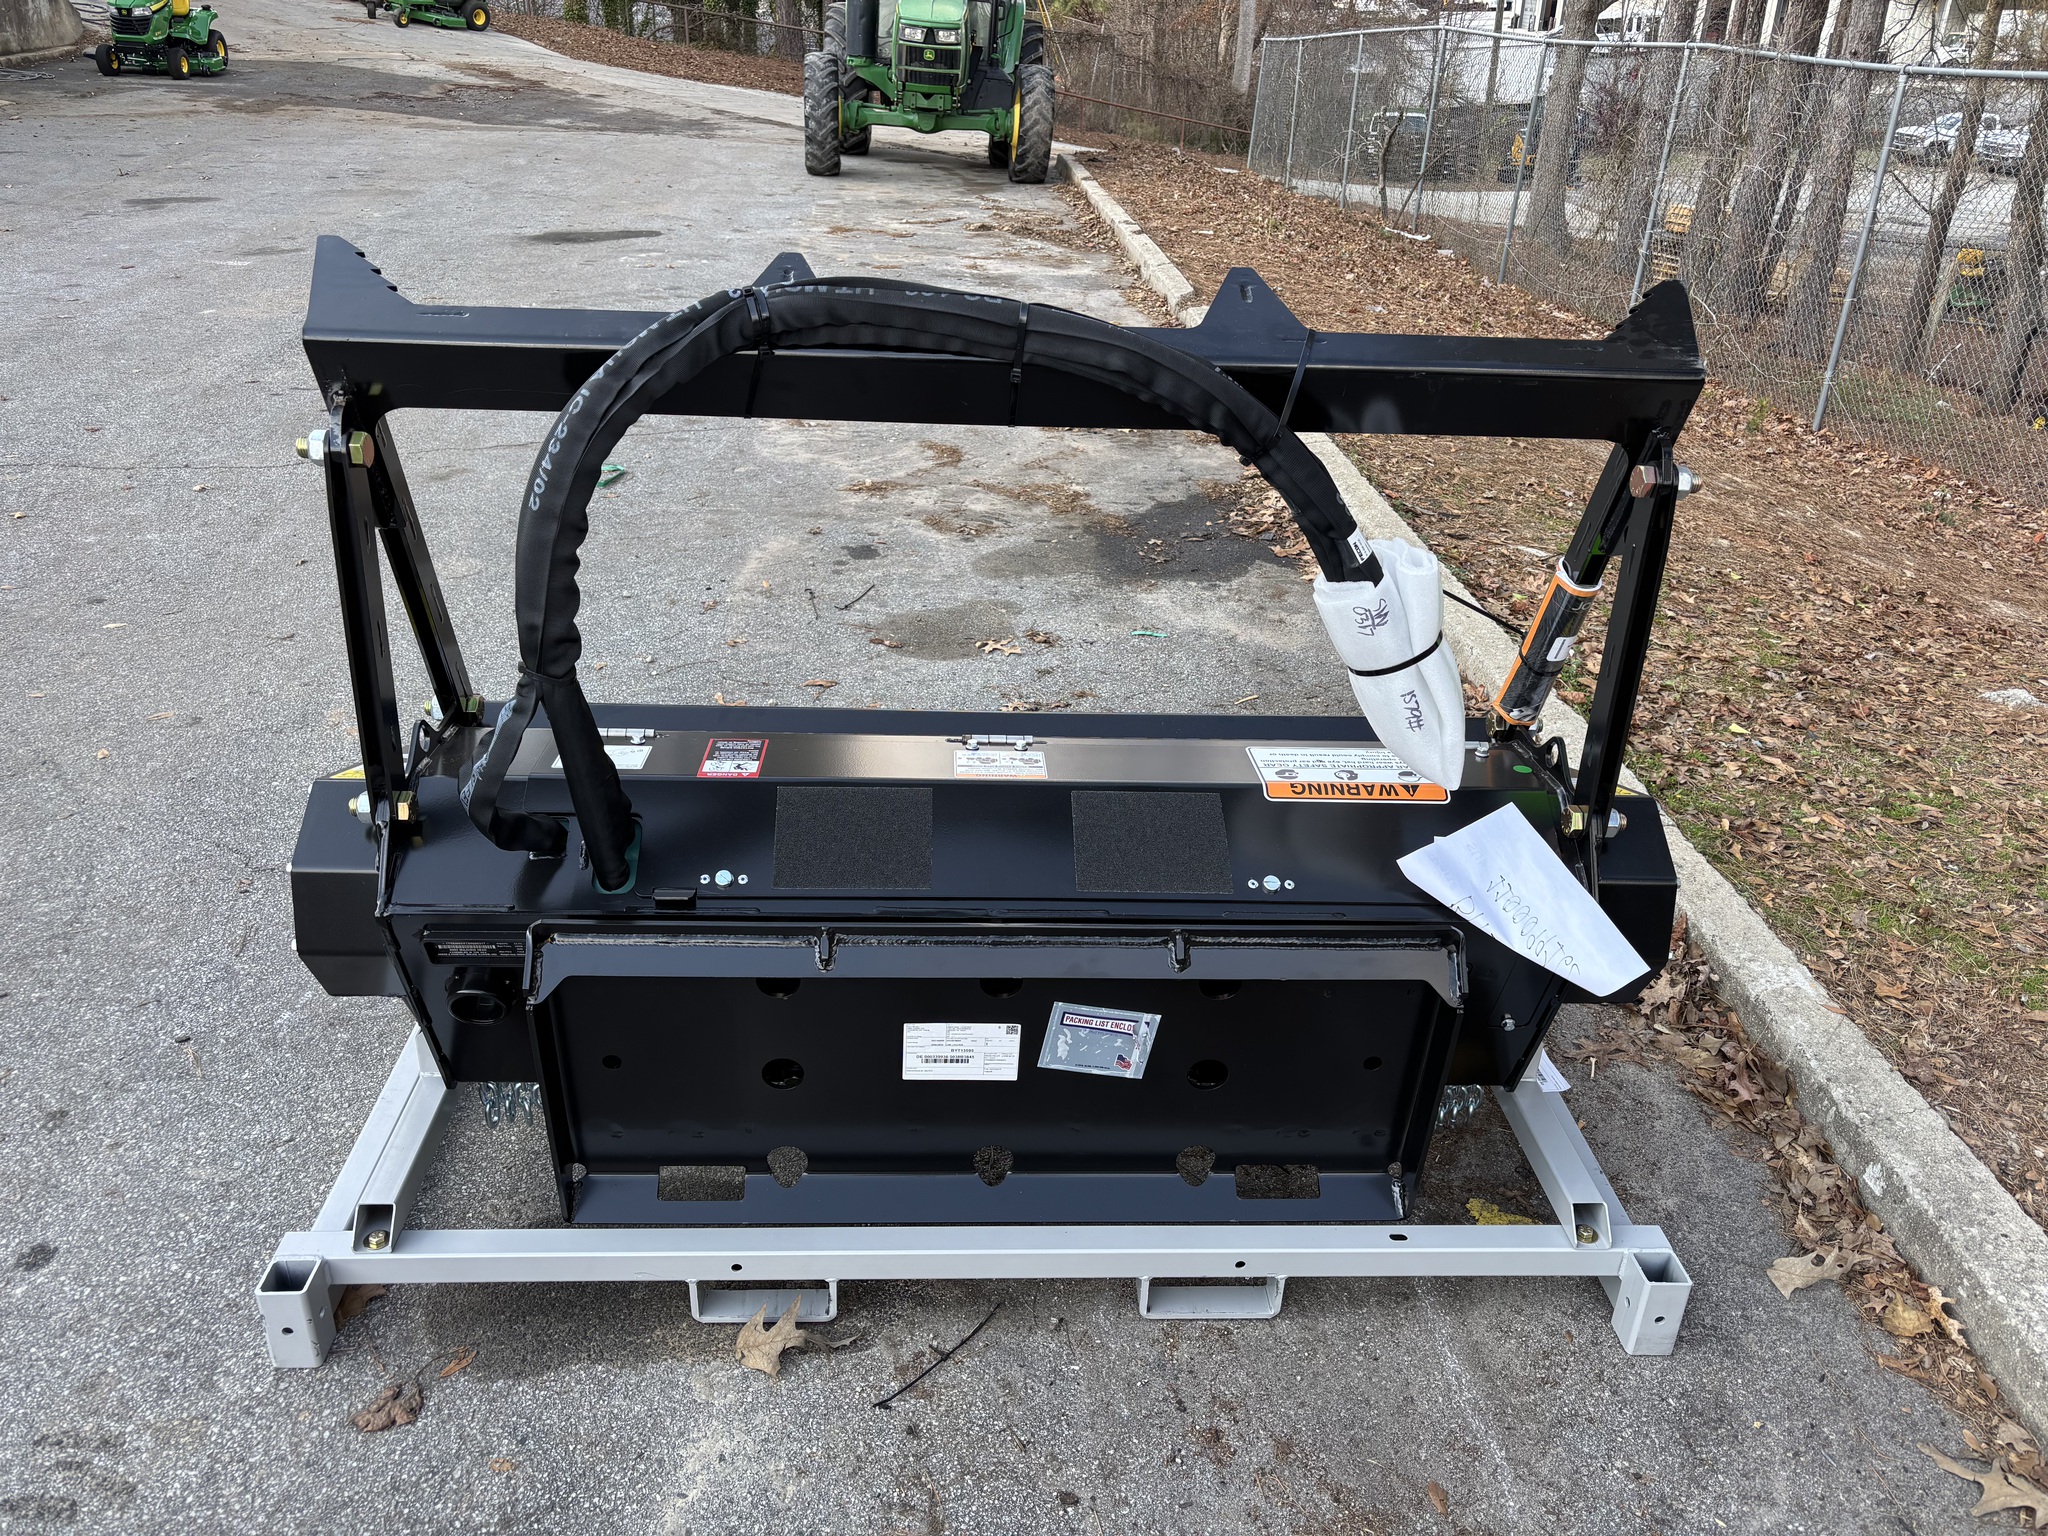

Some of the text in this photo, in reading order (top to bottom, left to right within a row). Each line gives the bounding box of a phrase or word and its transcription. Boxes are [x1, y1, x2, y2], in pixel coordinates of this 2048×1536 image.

[529, 388, 590, 511] IC-234/02
[1572, 601, 1591, 611] JO
[1290, 783, 1399, 796] WARNING
[1065, 1015, 1135, 1032] PACKING LIST ENCLO
